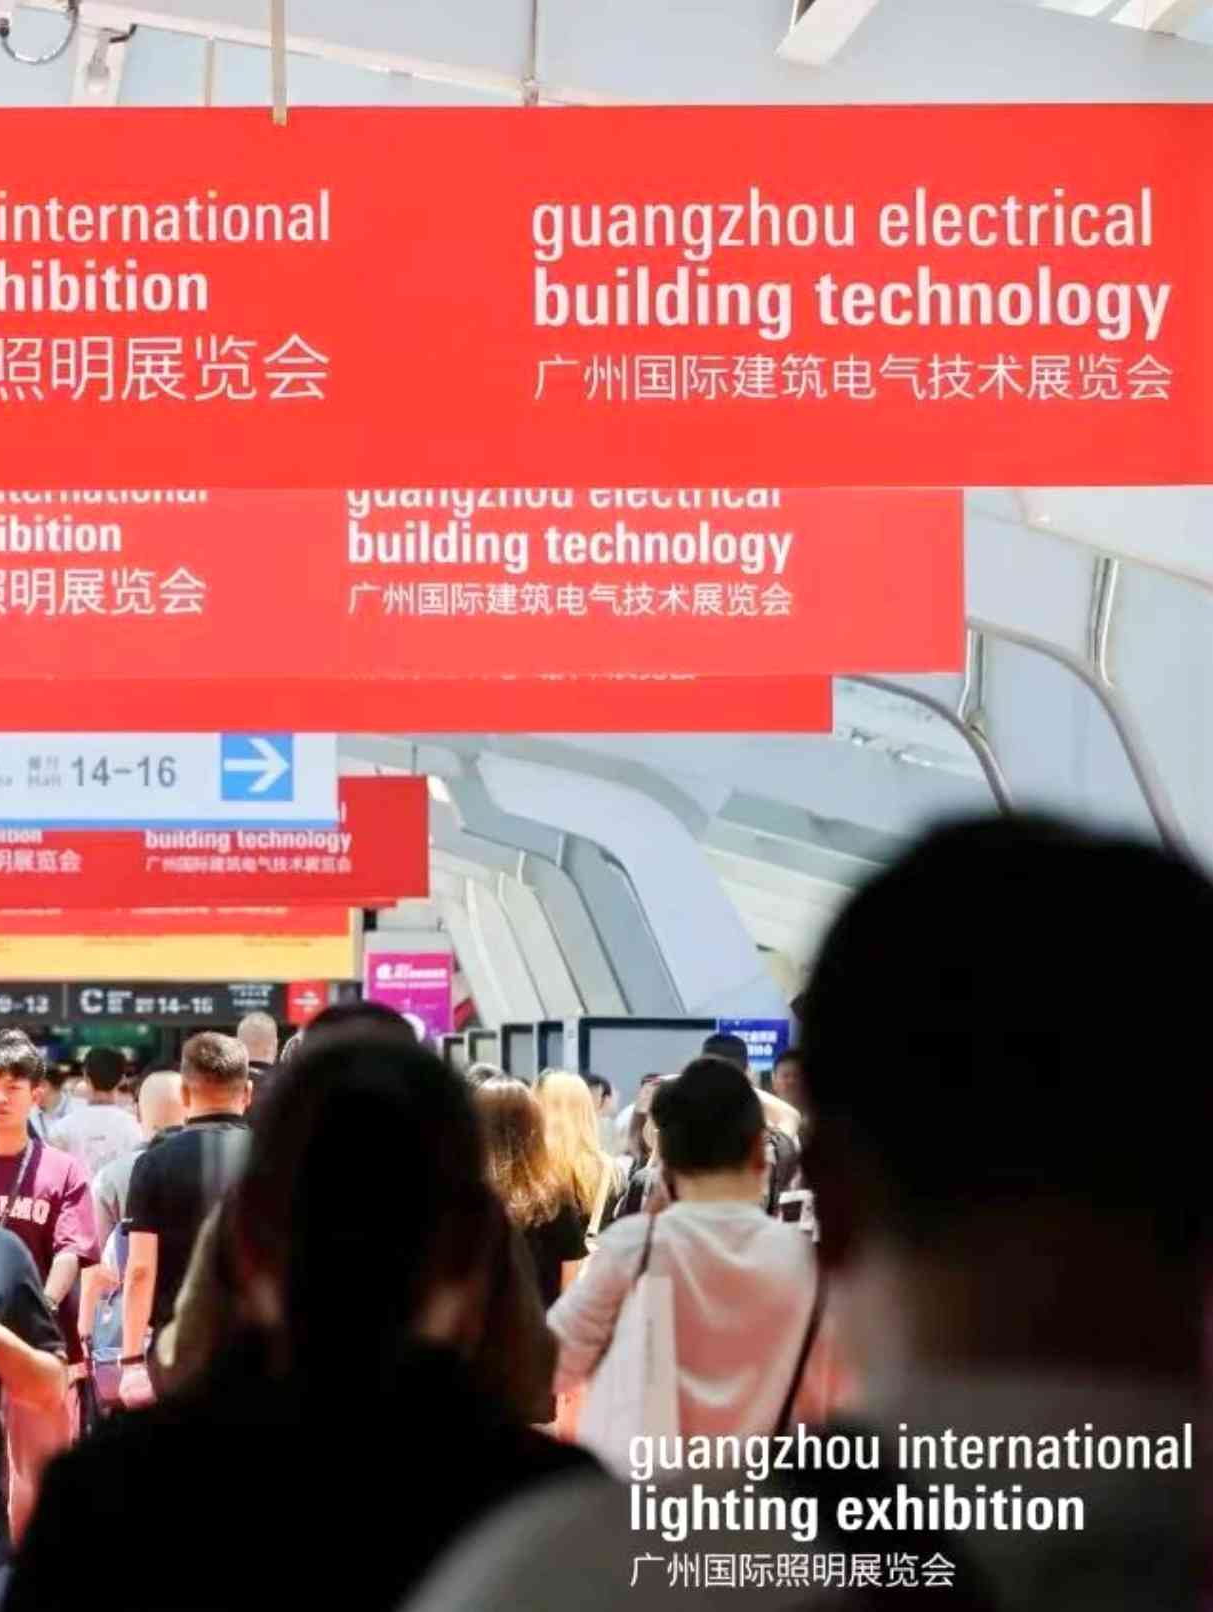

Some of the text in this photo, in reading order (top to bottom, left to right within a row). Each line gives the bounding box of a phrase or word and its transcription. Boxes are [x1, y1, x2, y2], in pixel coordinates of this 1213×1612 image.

[532, 187, 1152, 261] guangzhou electrical
[534, 266, 1171, 341] building technology
[534, 353, 1172, 401] 广州国际建筑电气技术展览会
[348, 520, 793, 574] building technology
[348, 582, 793, 617] 广州国际建筑电气技术展览会
[71, 755, 177, 787] 14-16
[144, 829, 352, 854] building technology
